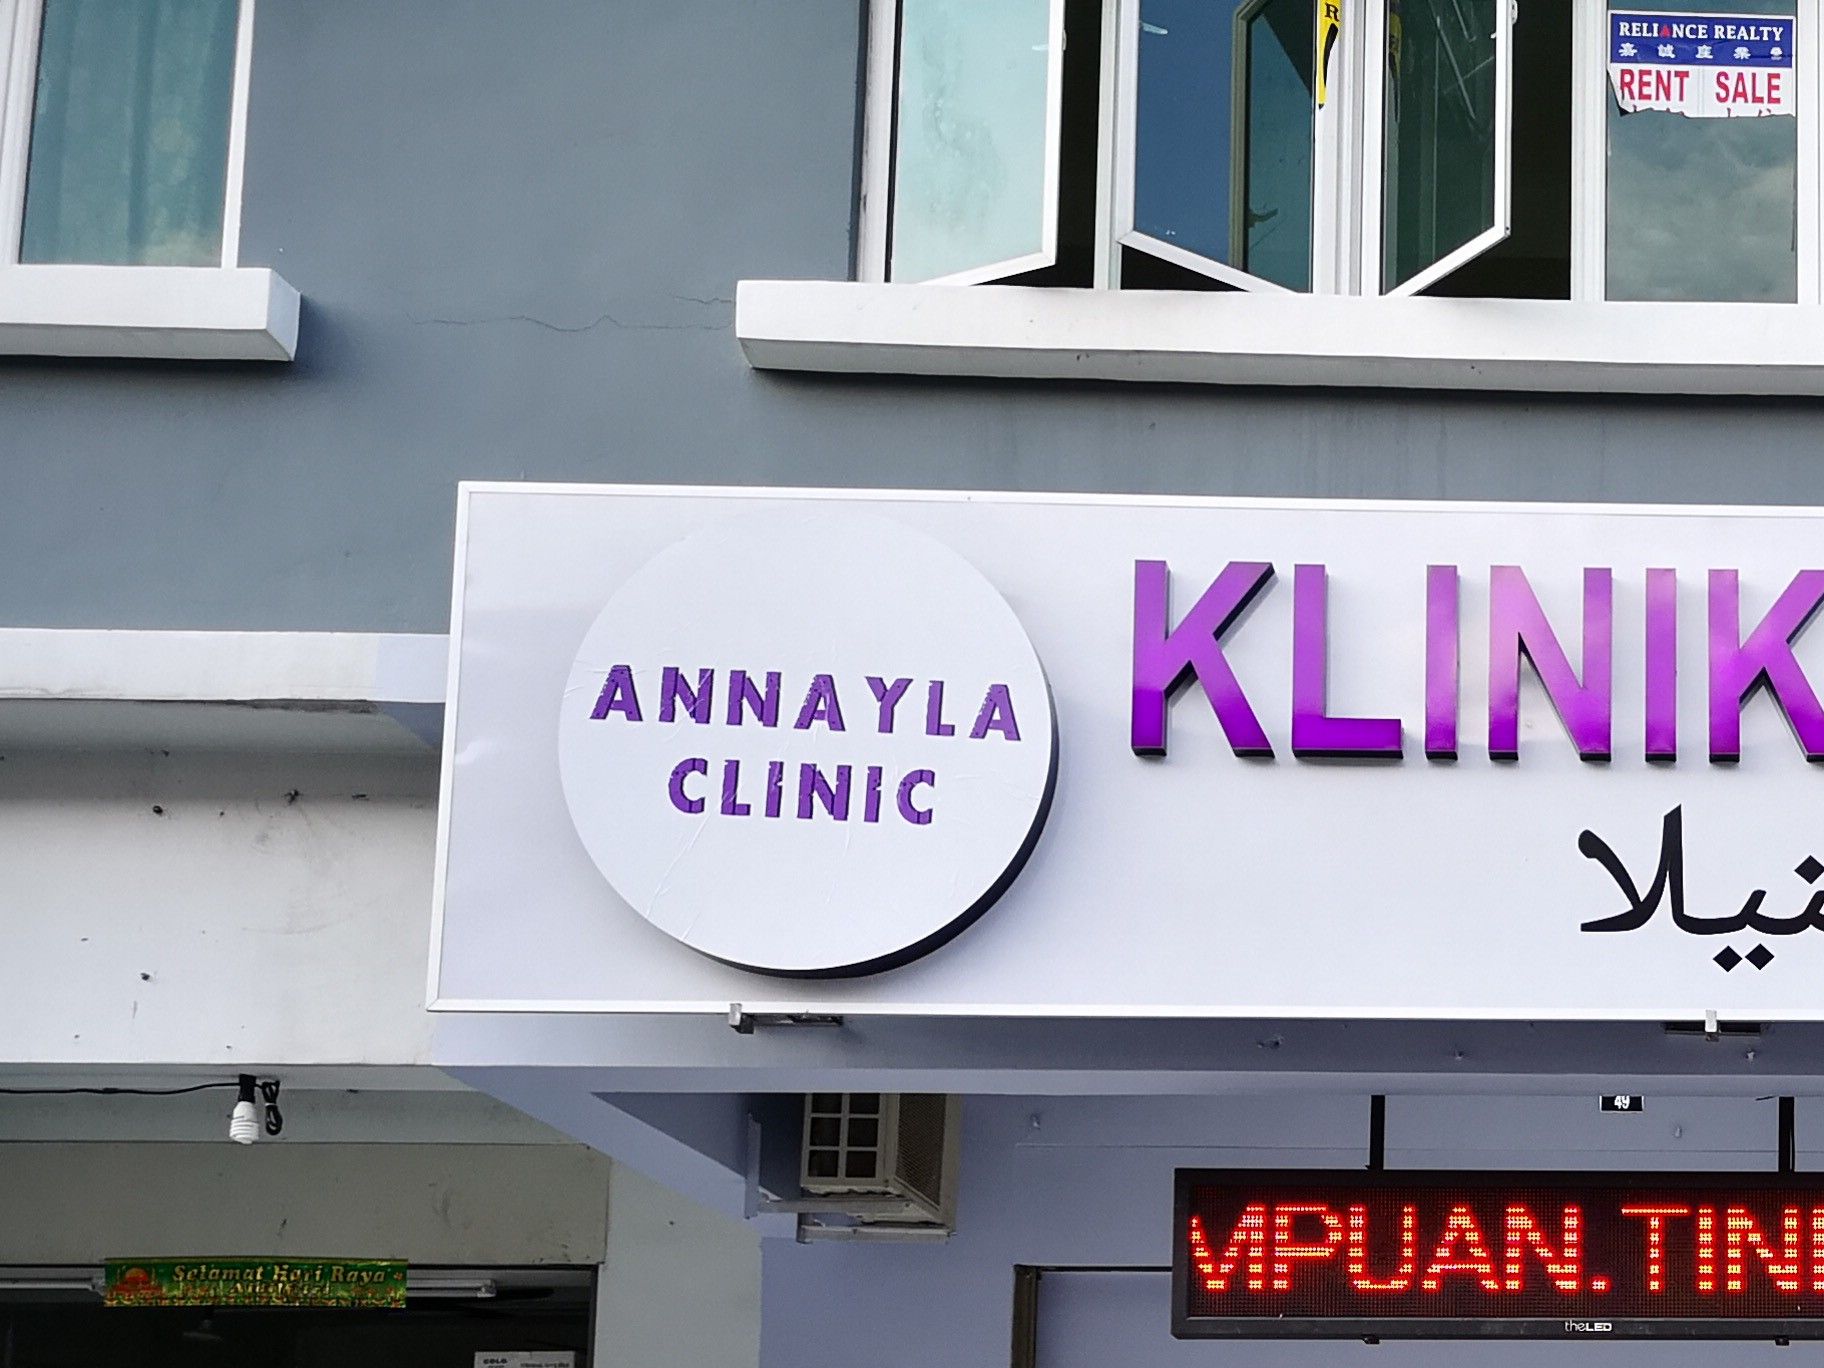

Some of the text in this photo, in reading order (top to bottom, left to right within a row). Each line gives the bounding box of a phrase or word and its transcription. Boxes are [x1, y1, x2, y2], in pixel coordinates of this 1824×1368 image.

[1619, 21, 1783, 41] RELIANCE REALTY
[1619, 68, 1781, 104] RENT SALE
[589, 664, 1022, 741] ANNAYLA
[668, 757, 936, 825] CLINIC
[331, 1266, 386, 1284] Raya
